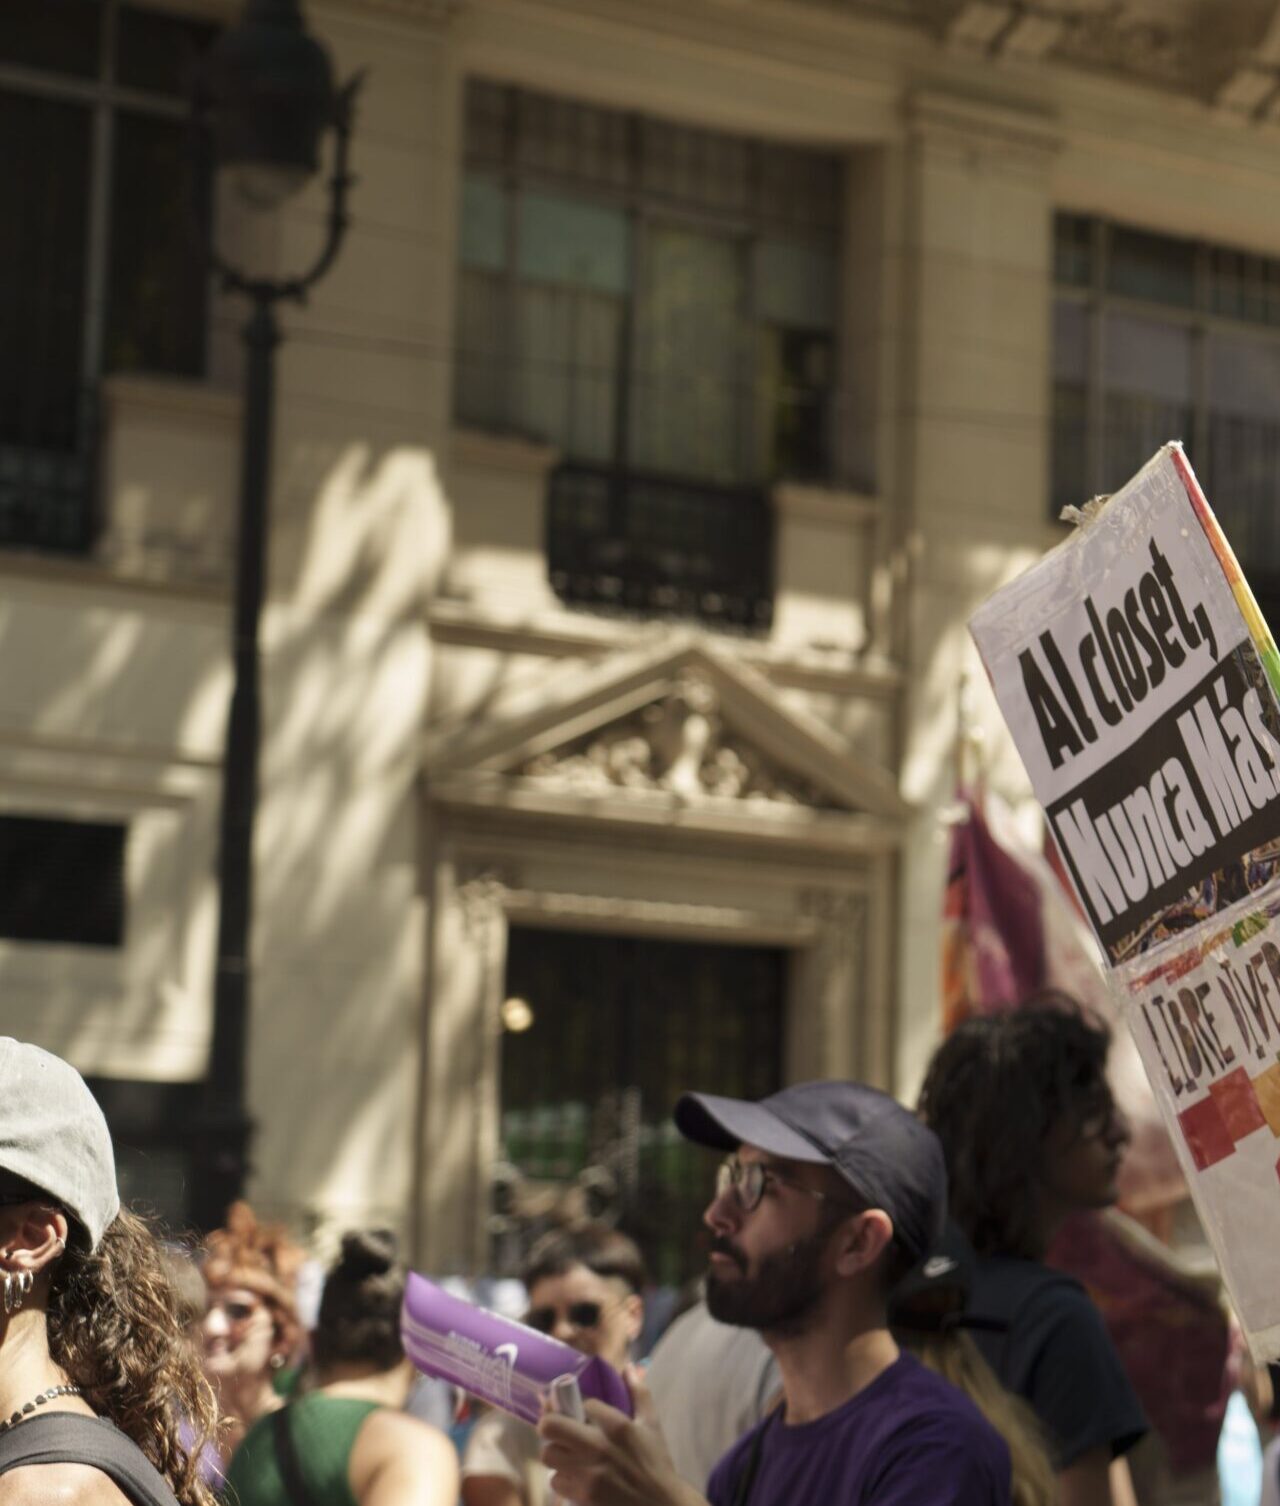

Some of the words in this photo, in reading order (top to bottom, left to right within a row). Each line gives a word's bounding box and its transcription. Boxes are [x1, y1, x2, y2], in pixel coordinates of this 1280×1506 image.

[1018, 629, 1099, 771] Al
[1079, 536, 1218, 727] closet,
[1054, 756, 1217, 926] Nunca
[1141, 981, 1236, 1097] LIBRE
